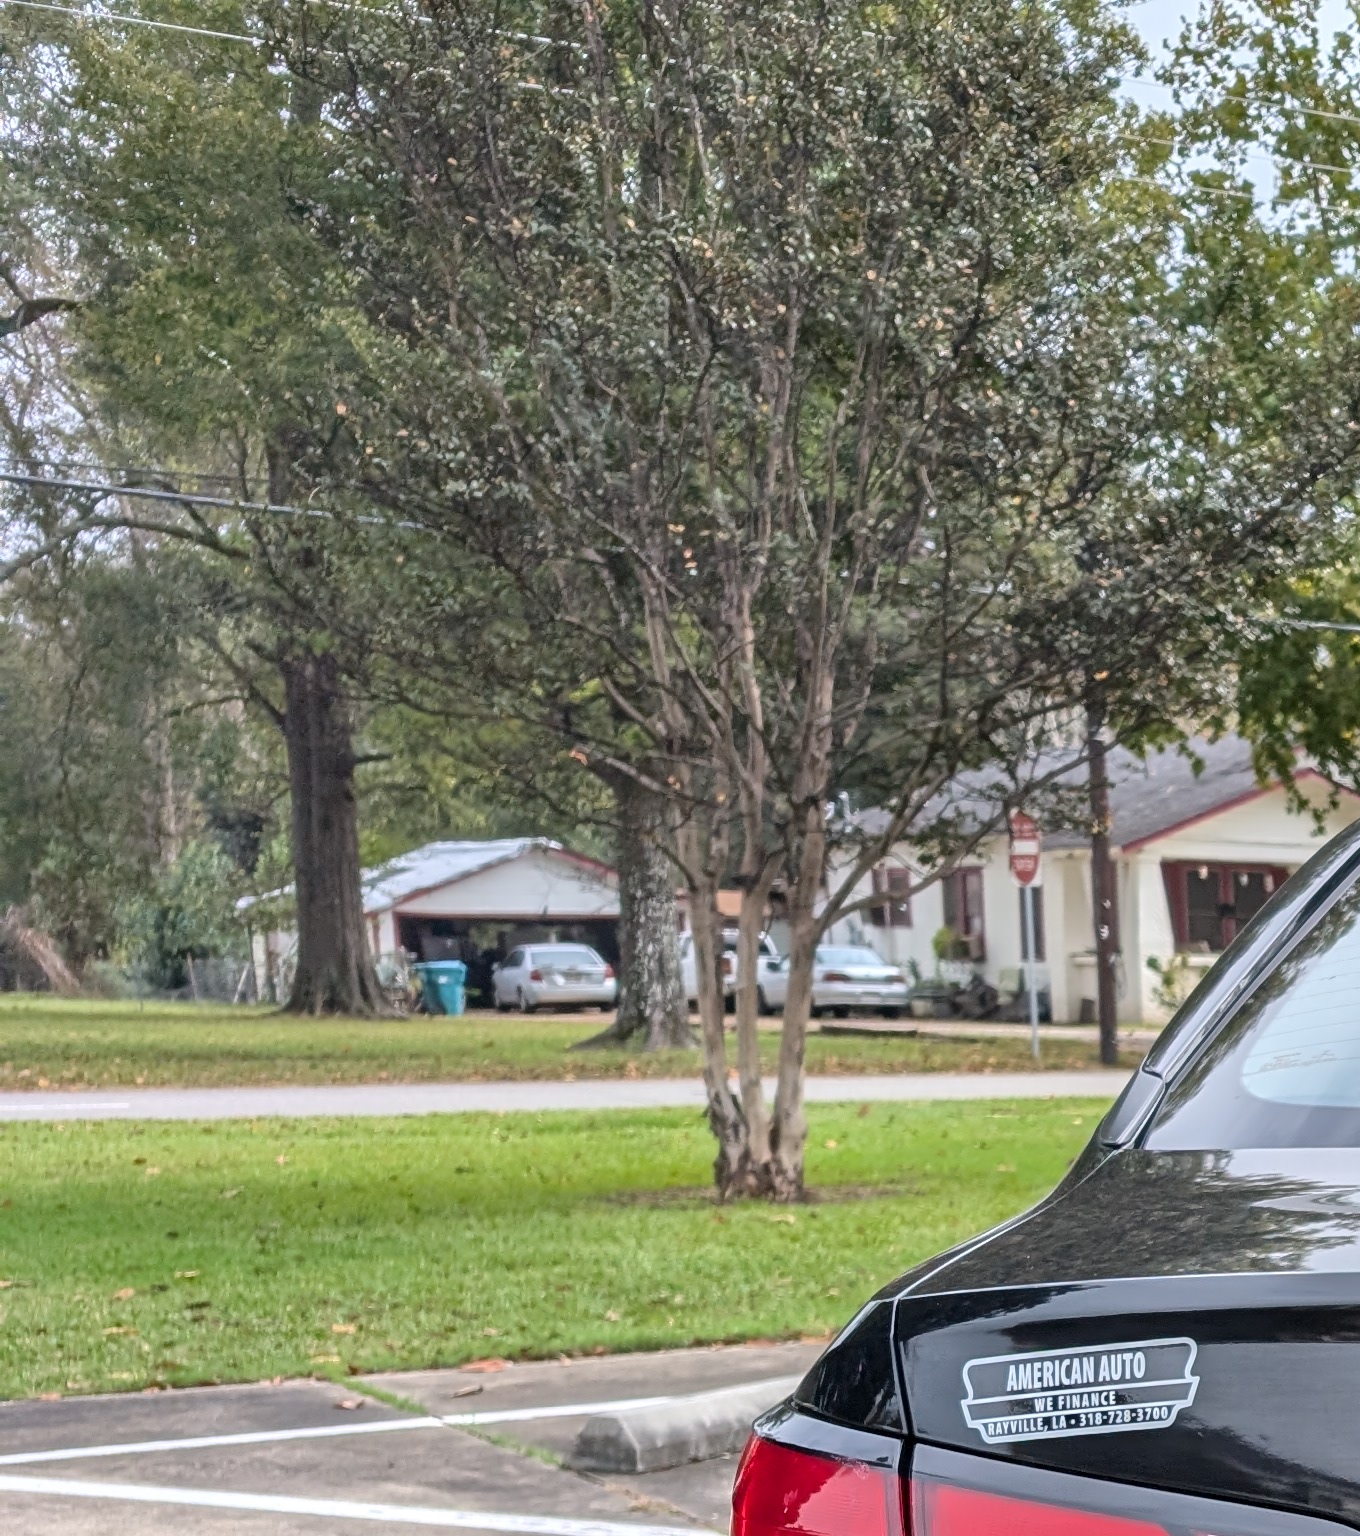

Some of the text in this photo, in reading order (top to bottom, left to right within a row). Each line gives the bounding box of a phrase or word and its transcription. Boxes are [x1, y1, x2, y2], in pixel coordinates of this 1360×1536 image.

[1006, 1351, 1146, 1392] AMERICAN AUTO
[1034, 1391, 1117, 1412] WE FINANCE
[987, 1406, 1169, 1437] RAYVILLE, LA 318-728-3700
